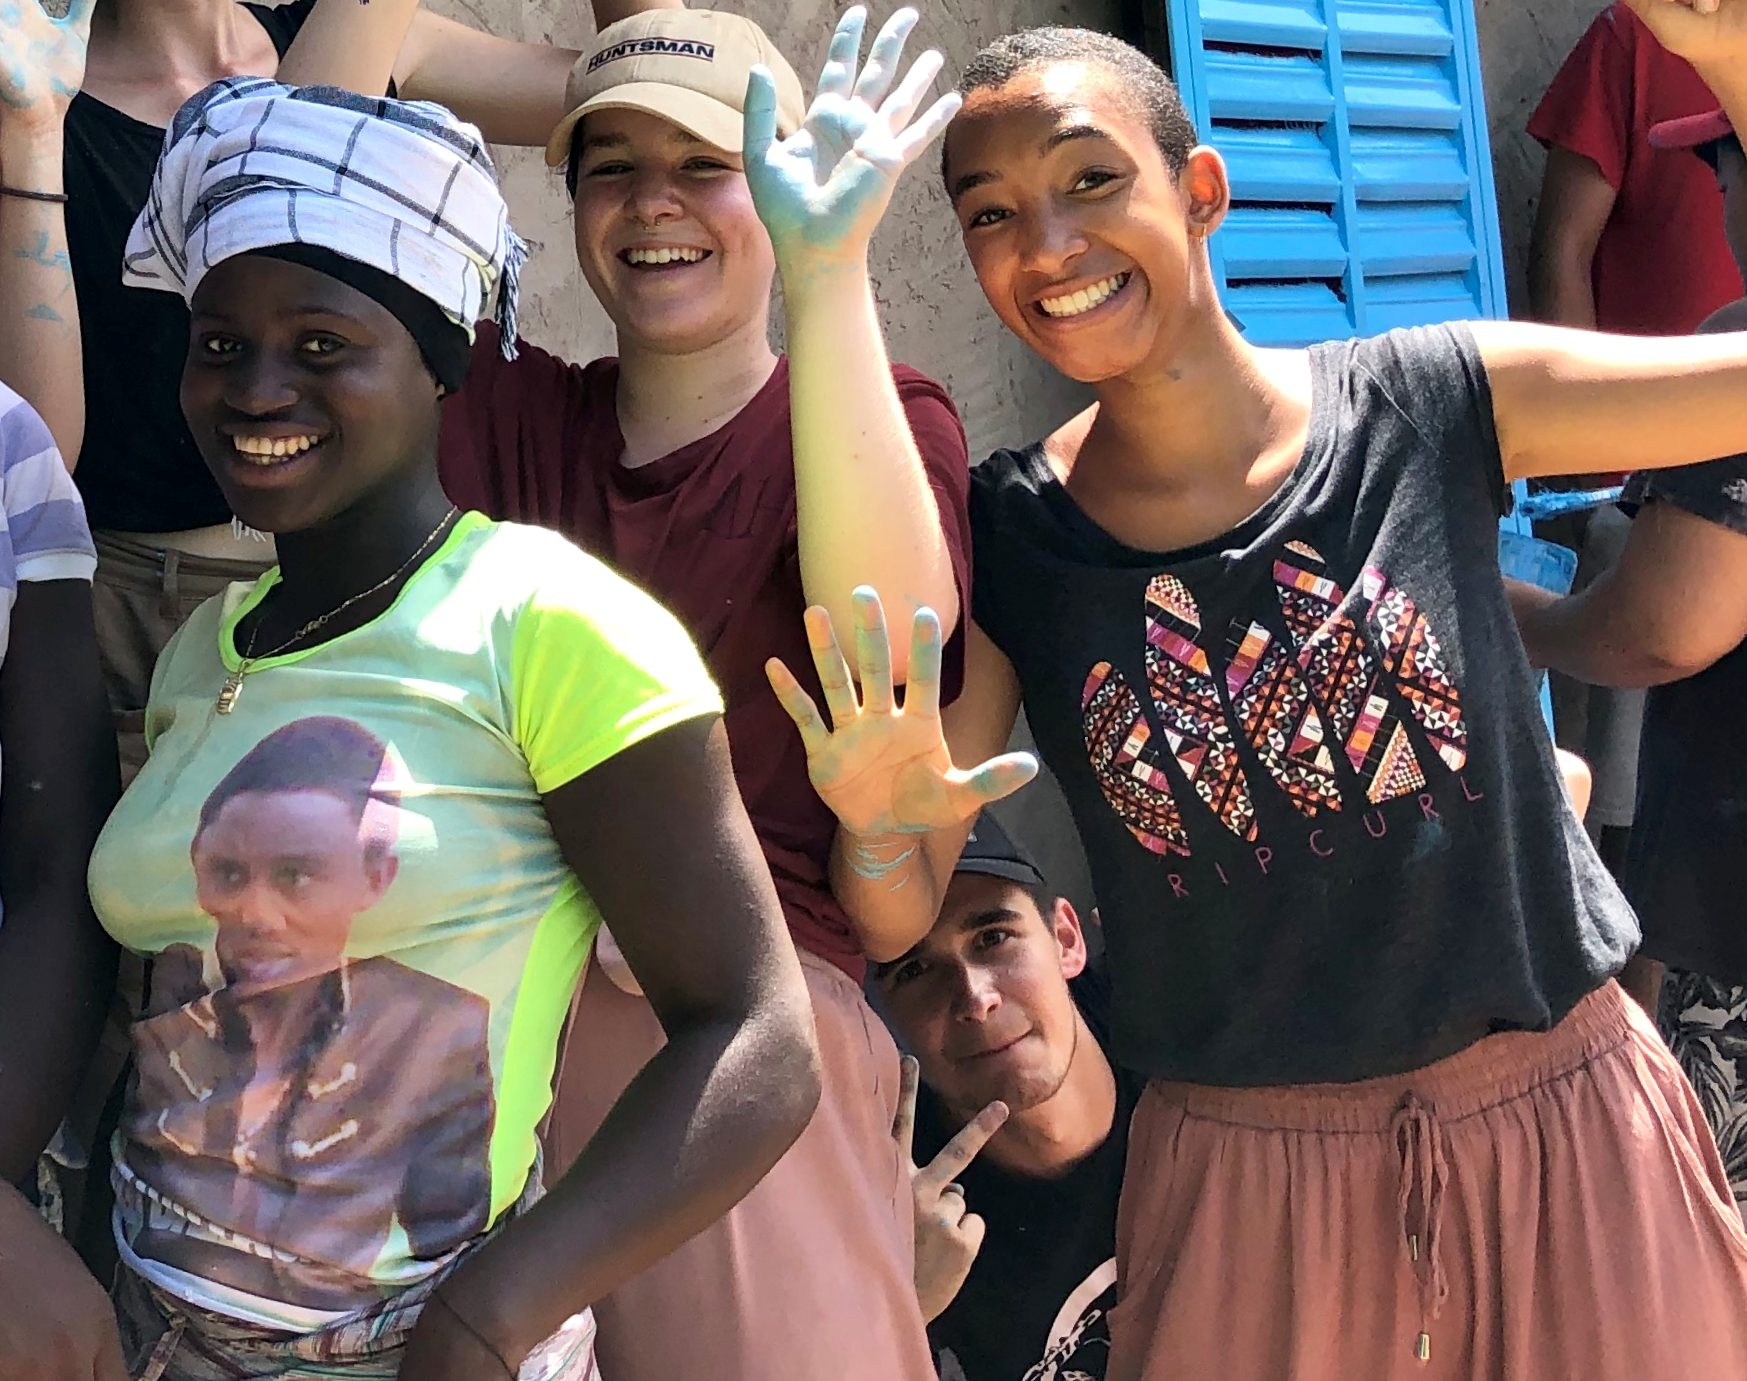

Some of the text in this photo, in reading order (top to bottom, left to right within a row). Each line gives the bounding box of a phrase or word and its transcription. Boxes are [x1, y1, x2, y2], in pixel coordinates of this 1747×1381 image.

[589, 40, 715, 67] HUNTSMAN
[1167, 775, 1483, 899] RIP CURL
